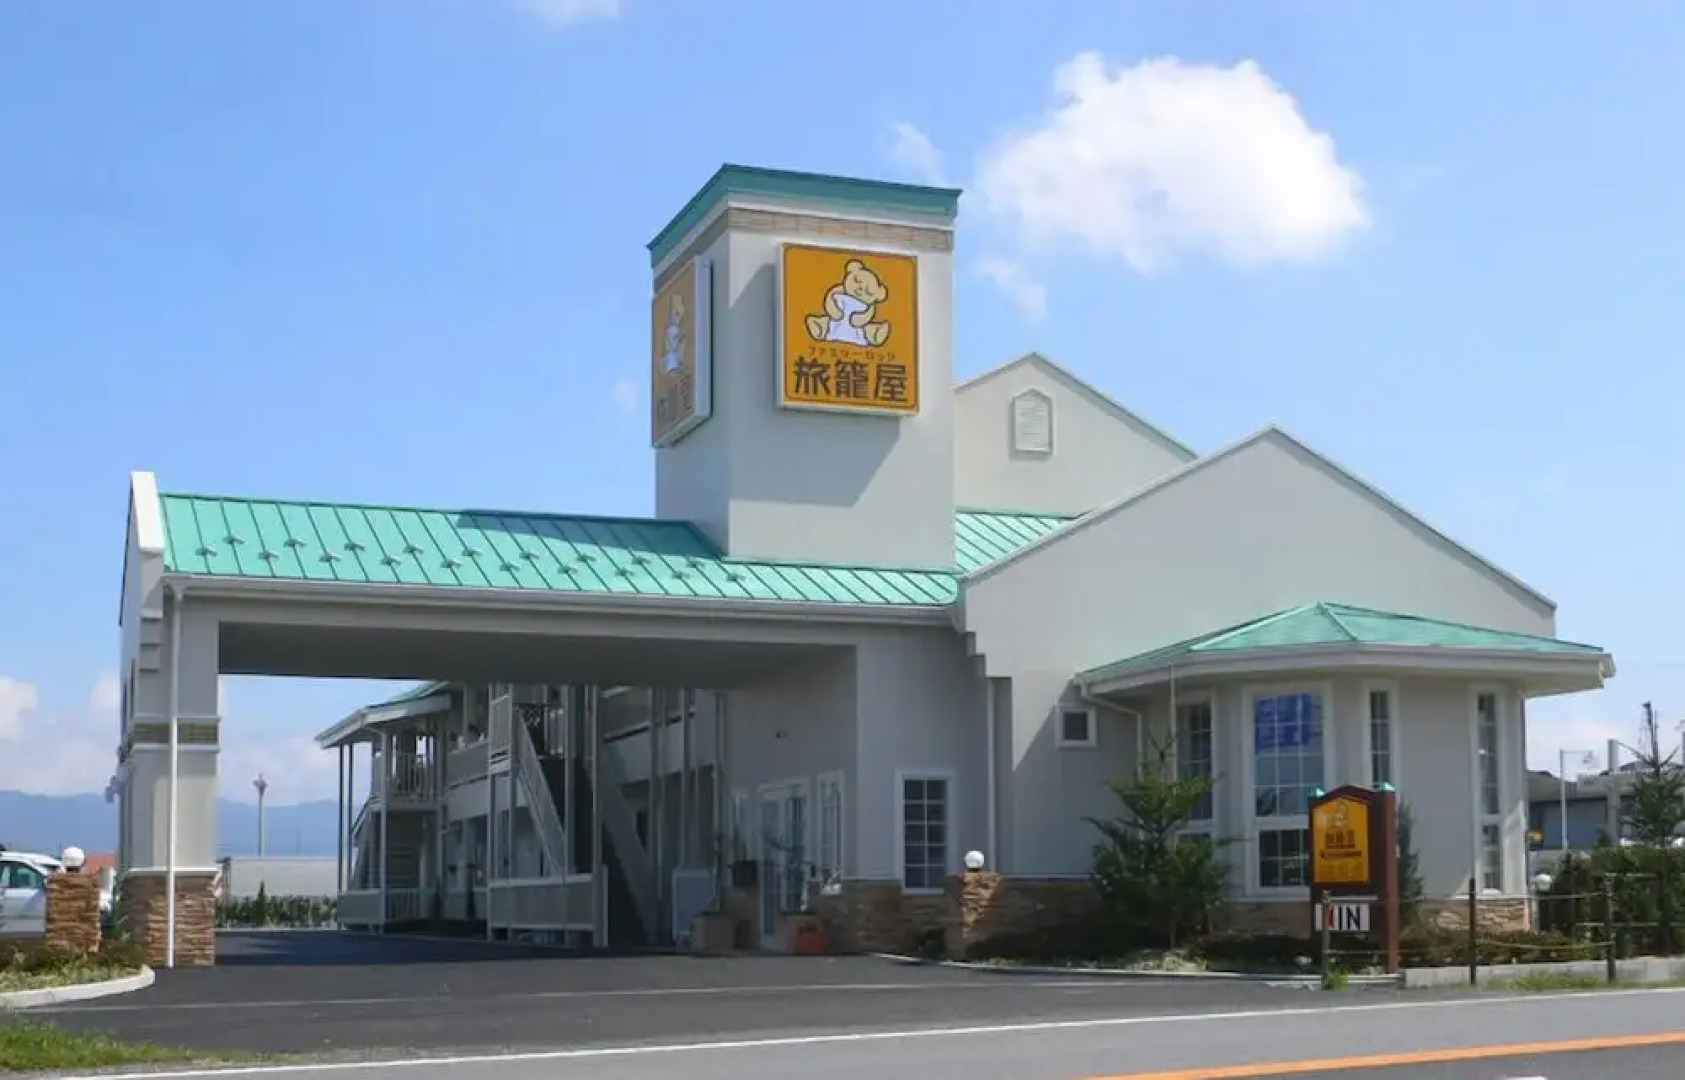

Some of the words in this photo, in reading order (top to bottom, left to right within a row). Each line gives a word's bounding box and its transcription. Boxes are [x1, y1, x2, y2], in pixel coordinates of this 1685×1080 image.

[793, 356, 908, 402] 旅籠屋
[1338, 905, 1361, 930] IN
